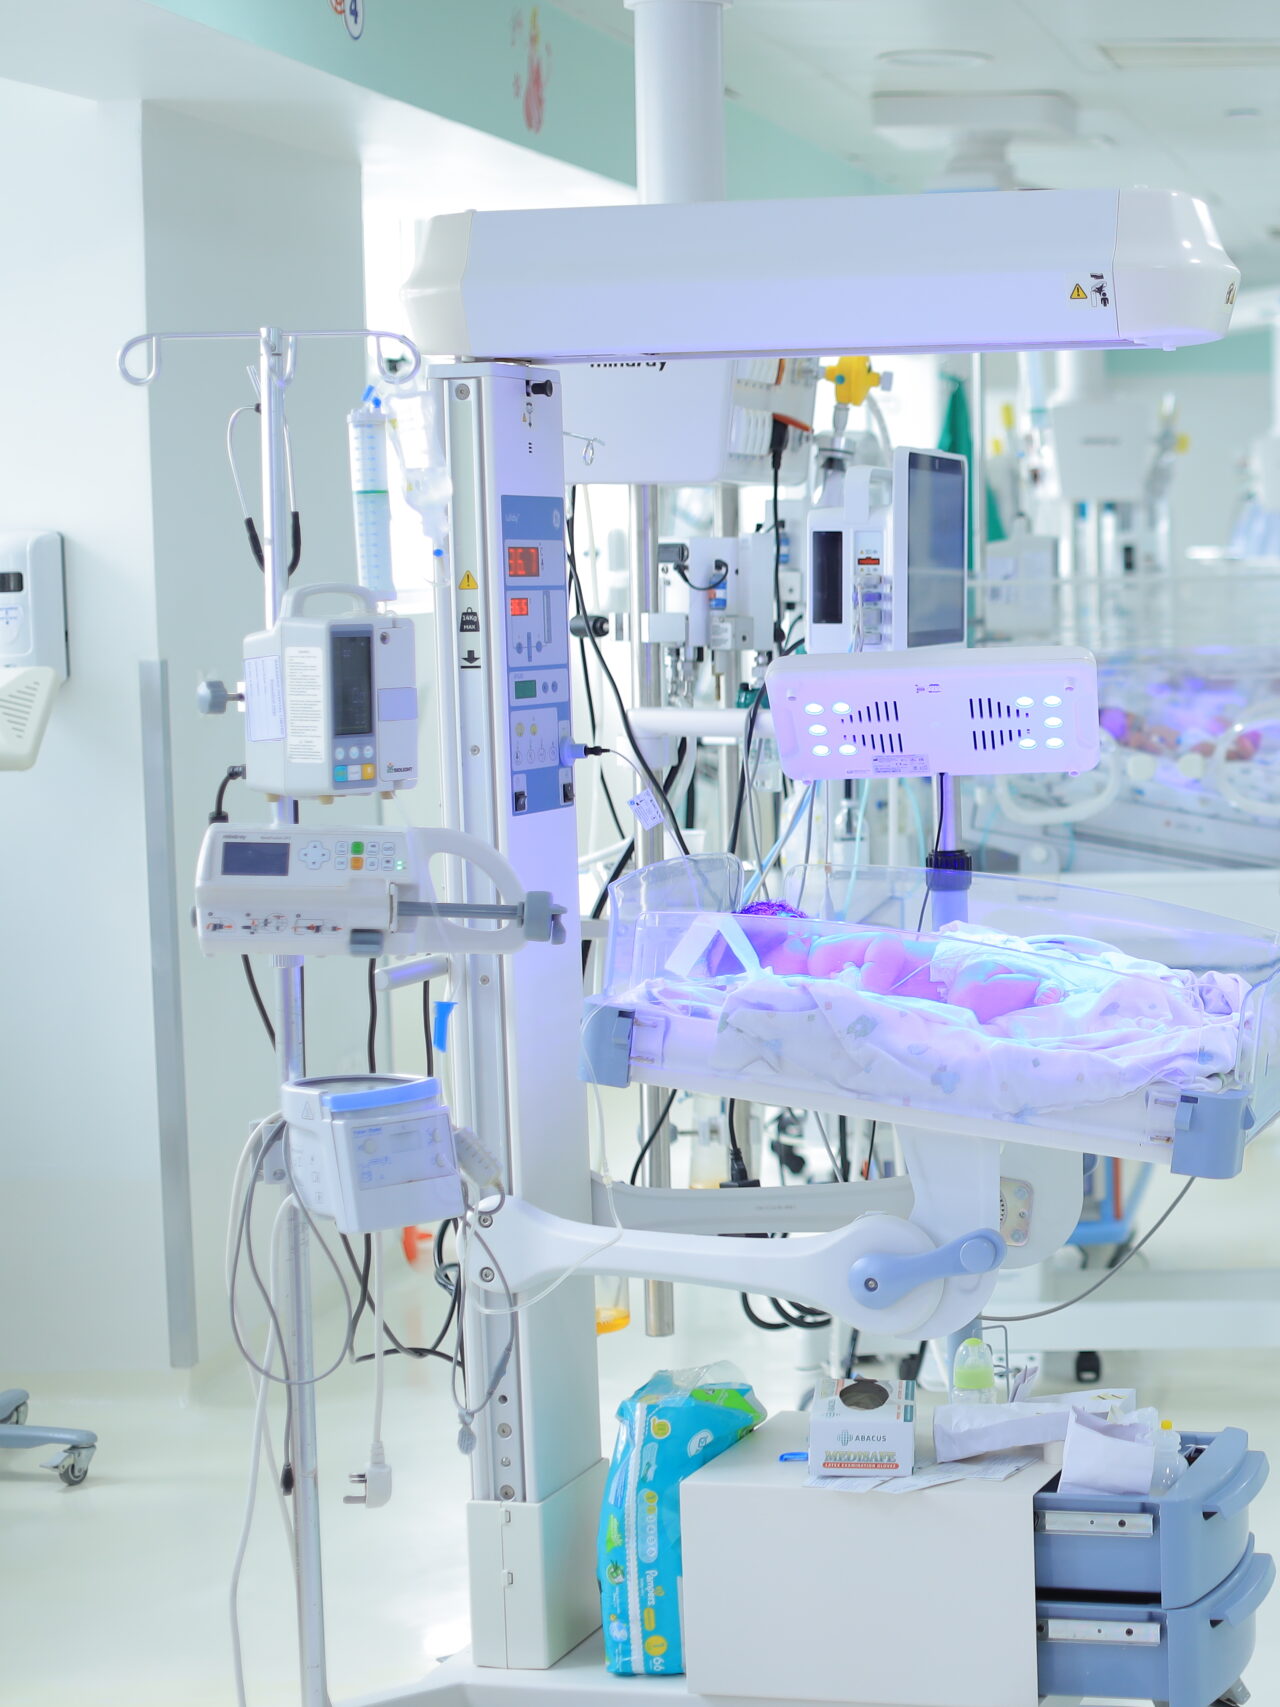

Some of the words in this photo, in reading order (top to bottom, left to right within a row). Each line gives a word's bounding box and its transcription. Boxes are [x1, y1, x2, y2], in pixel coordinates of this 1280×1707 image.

[854, 1434, 887, 1442] ABACUS
[645, 1569, 658, 1606] Pampers
[653, 1657, 665, 1672] 66
